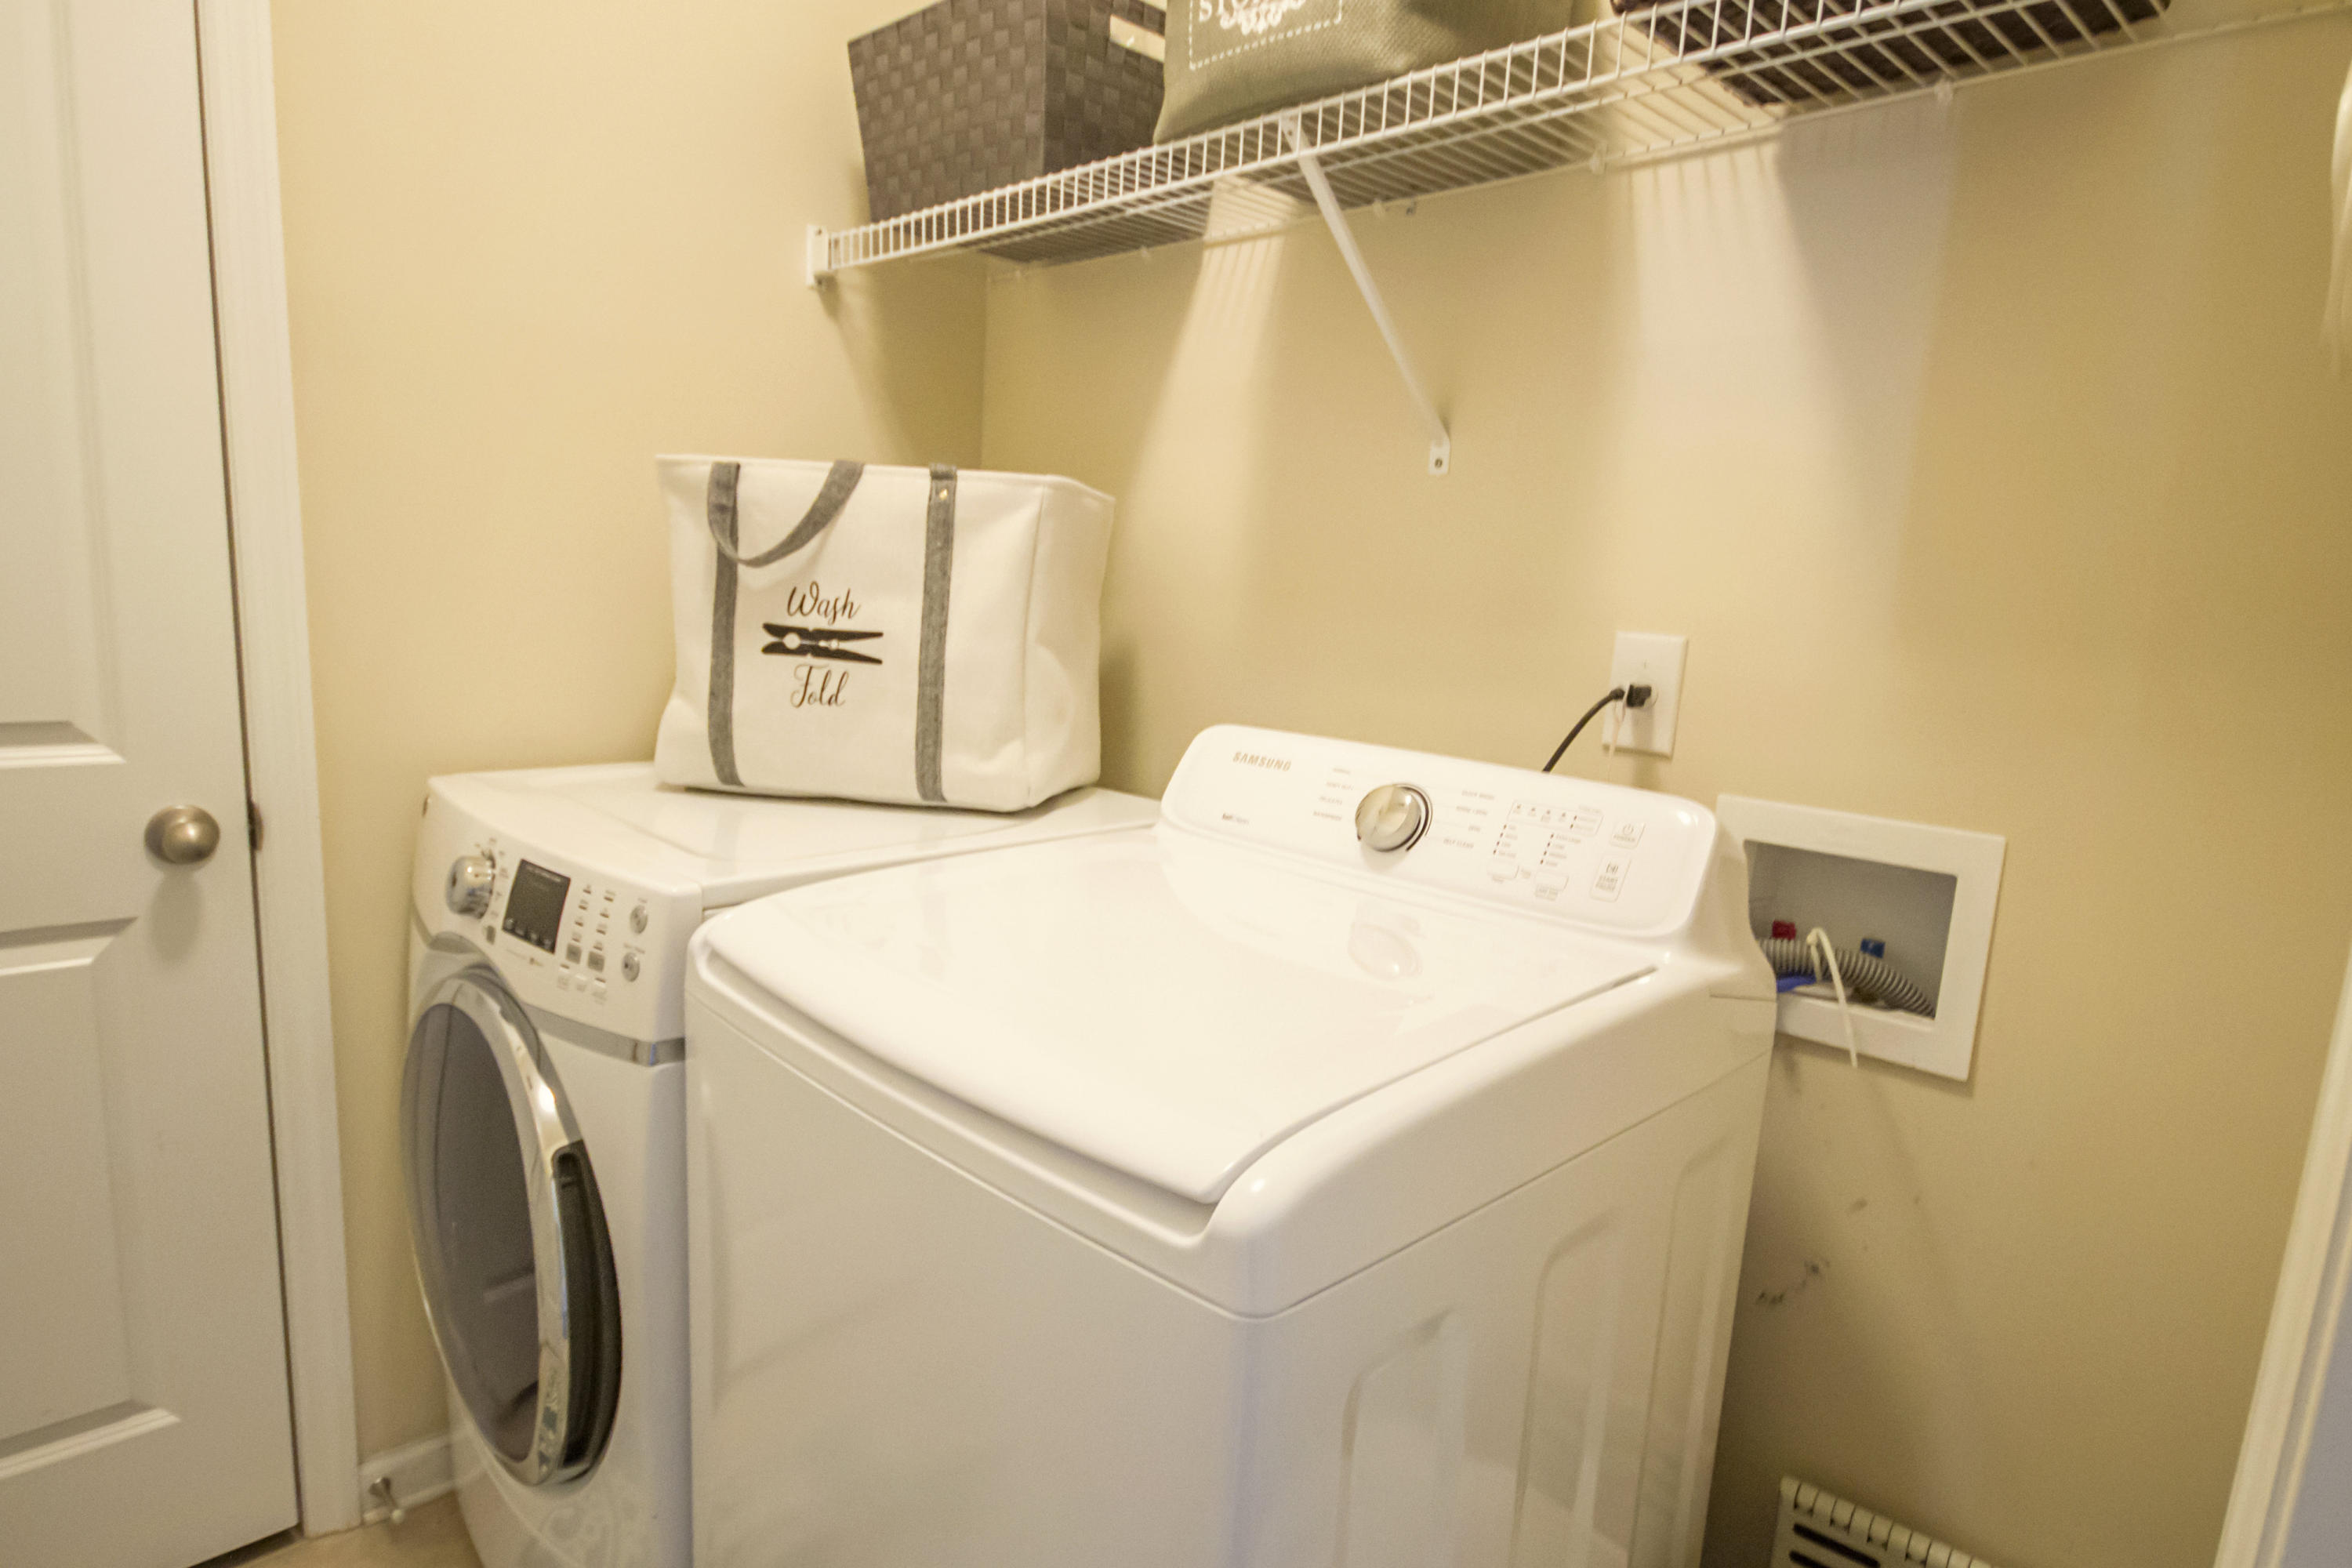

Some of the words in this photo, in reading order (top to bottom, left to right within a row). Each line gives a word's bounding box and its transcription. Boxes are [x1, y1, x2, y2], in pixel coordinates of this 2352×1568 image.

[786, 581, 861, 625] Wash
[790, 664, 848, 708] Fold
[1232, 750, 1292, 772] SAMSUNG
